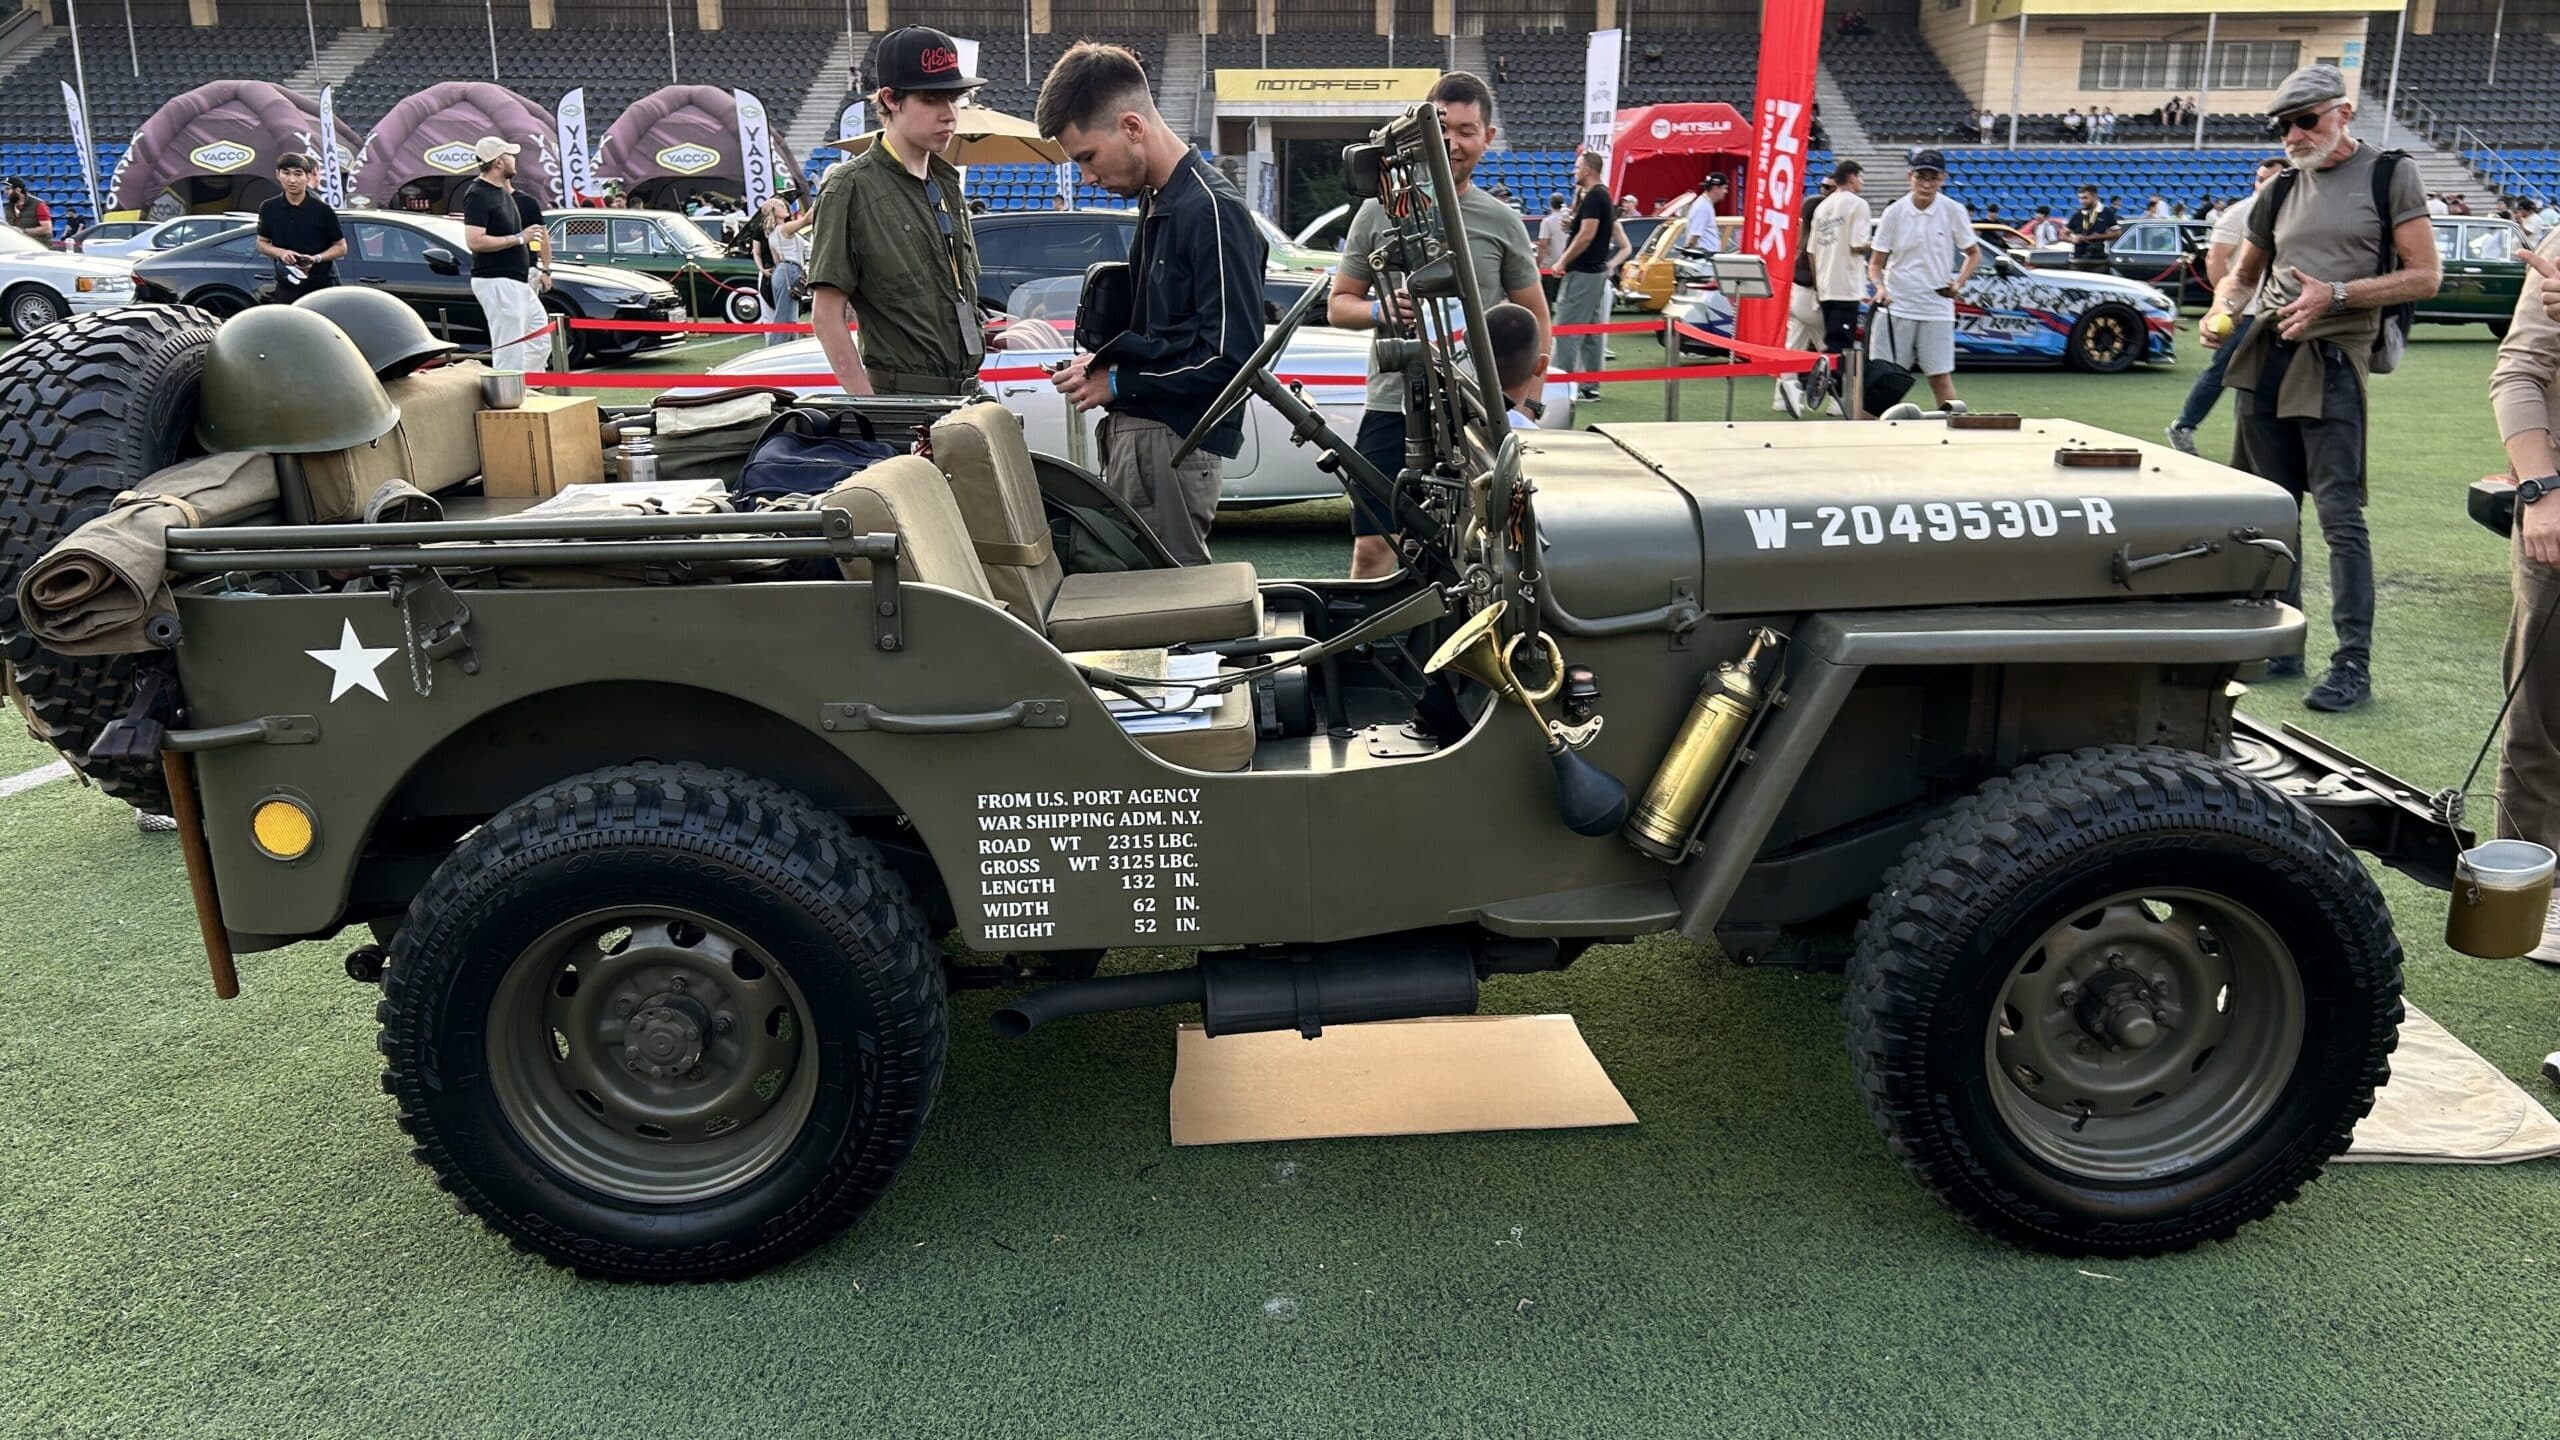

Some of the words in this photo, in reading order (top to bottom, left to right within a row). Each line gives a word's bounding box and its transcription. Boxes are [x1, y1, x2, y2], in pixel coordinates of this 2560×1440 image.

[1256, 79, 1399, 91] MOTORFEST
[1758, 99, 1776, 173] SPARK
[202, 151, 246, 161] YACCO
[324, 122, 341, 209] YACCO
[346, 131, 378, 193] YACC
[566, 125, 585, 192] YACC
[667, 153, 711, 163] YACCO
[106, 131, 145, 209] YACCO
[1760, 100, 1802, 261] NGK
[1744, 497, 2117, 550] W-2049530-R
[978, 793, 1031, 809] FROM
[1037, 792, 1068, 806] U.S.
[1073, 791, 1123, 805] PORT
[1127, 789, 1200, 804] AGENCY
[978, 816, 1022, 830] WAR
[1027, 813, 1114, 829] SHIPPING
[1119, 811, 1166, 826] ADM.
[1172, 811, 1202, 824] N.Y.
[979, 839, 1030, 854] ROAD
[1050, 836, 1081, 851] WT
[1108, 834, 1153, 849] 2315
[1159, 833, 1197, 848] LBC.
[981, 859, 1040, 874] GROSS
[1069, 856, 1100, 871] WT
[1109, 855, 1154, 869] 3125
[1160, 854, 1198, 868] LBC.
[982, 879, 1055, 895] LENGTH
[1122, 875, 1155, 889] 132
[1175, 873, 1199, 887] IN.
[983, 901, 1049, 917] WIDTH
[1134, 898, 1155, 912] 62
[1176, 896, 1199, 910] IN.
[985, 922, 1055, 938] HEIGHT
[1135, 919, 1156, 932] 52
[1176, 918, 1200, 931] IN.
